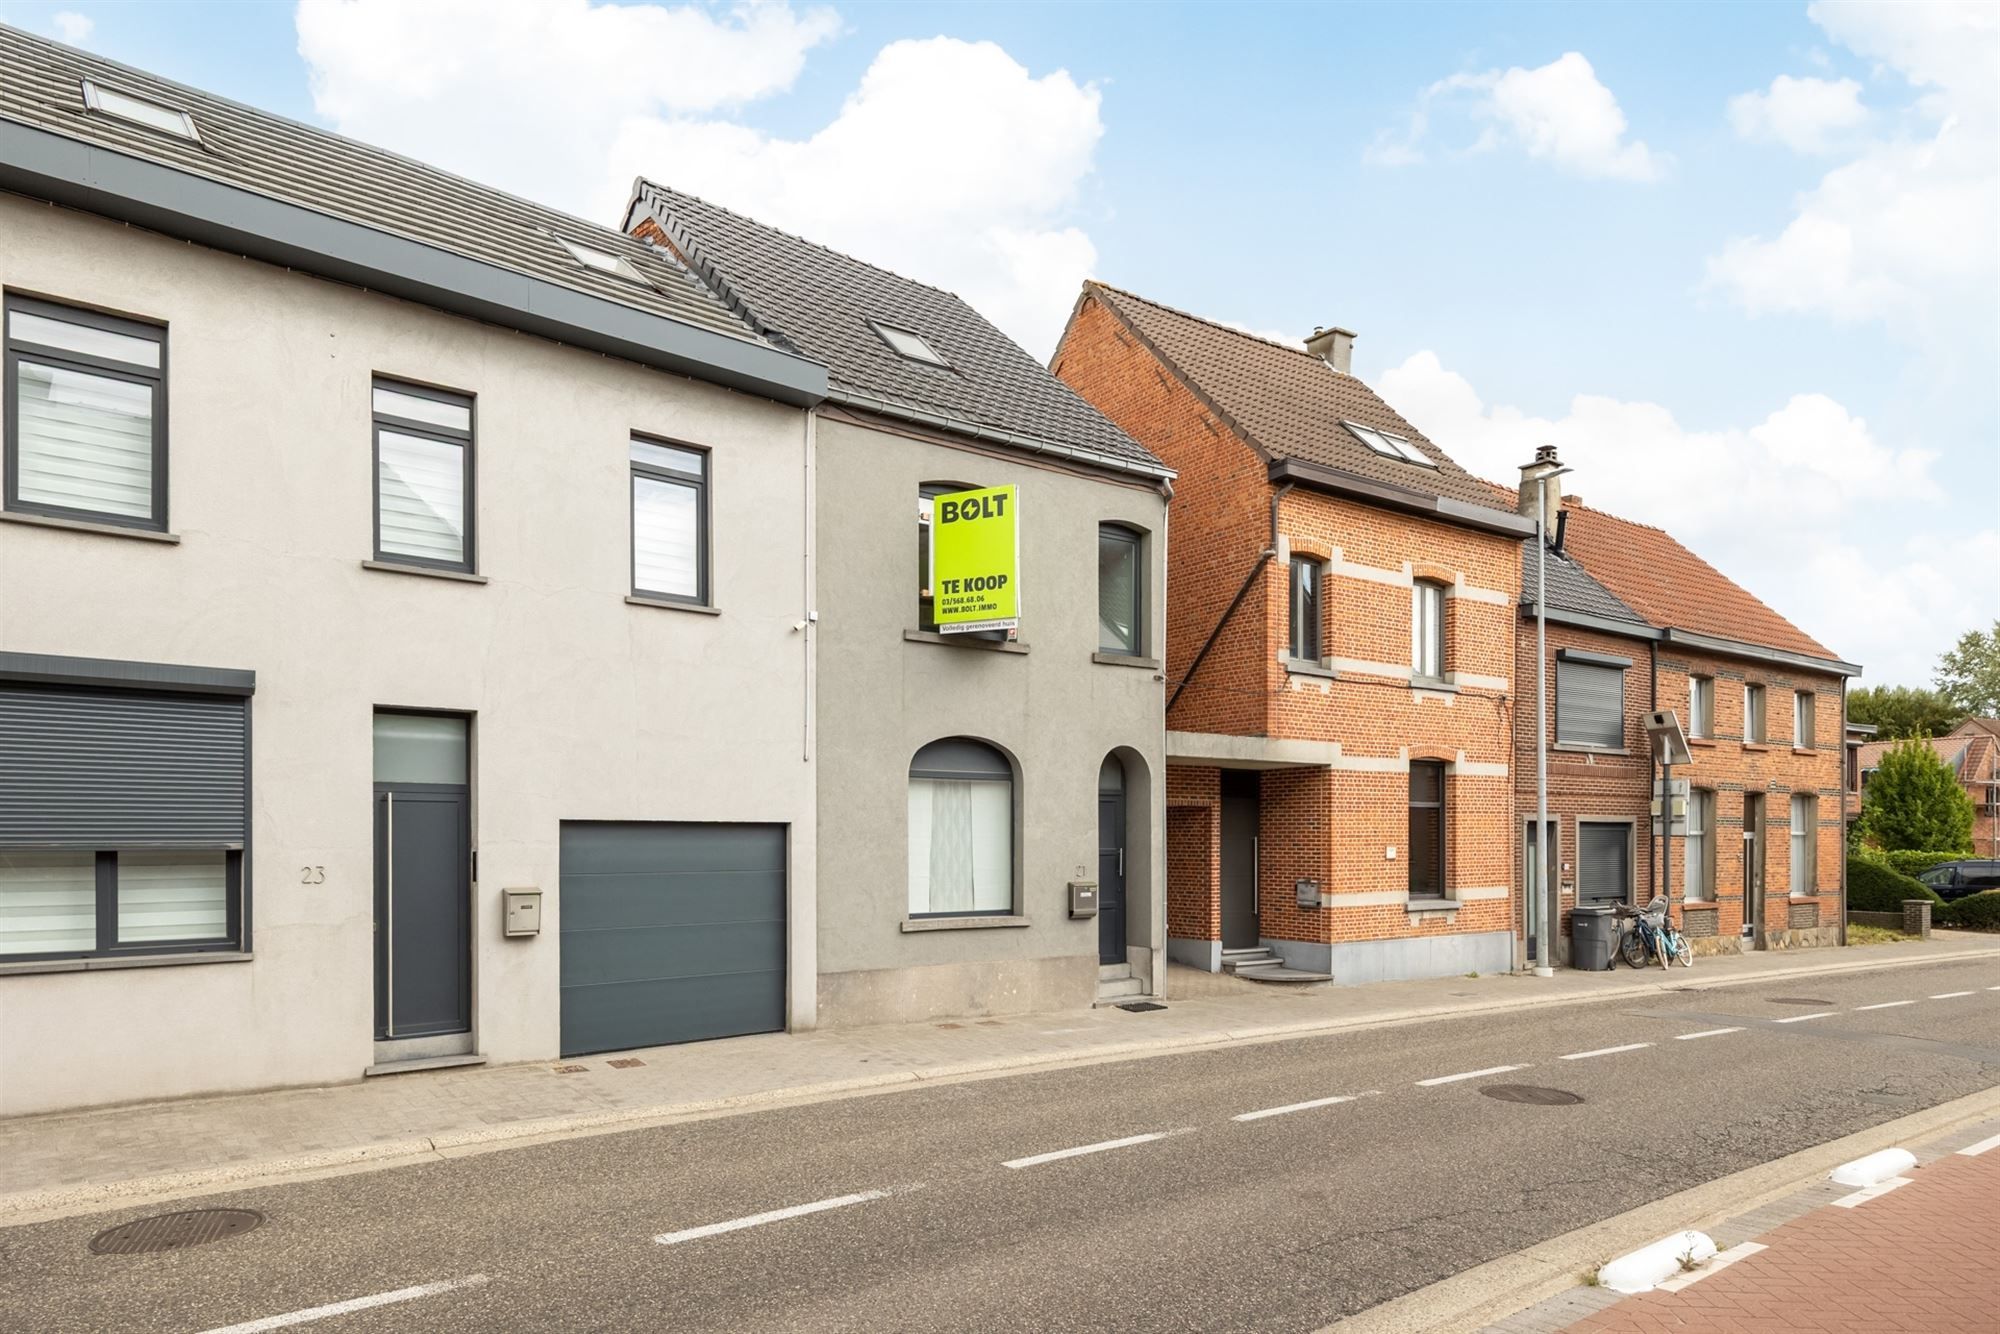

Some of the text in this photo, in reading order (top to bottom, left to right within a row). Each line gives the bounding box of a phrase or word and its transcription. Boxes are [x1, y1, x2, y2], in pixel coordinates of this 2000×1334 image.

[941, 494, 1008, 524] BOLT
[942, 574, 1008, 595] TE KOOP
[942, 594, 985, 605] 03/568.68.06
[942, 603, 998, 615] WWW.BOLT.IMMO
[942, 623, 965, 632] Volledig
[966, 620, 1001, 631] gerenoveerd
[301, 866, 326, 885] 23
